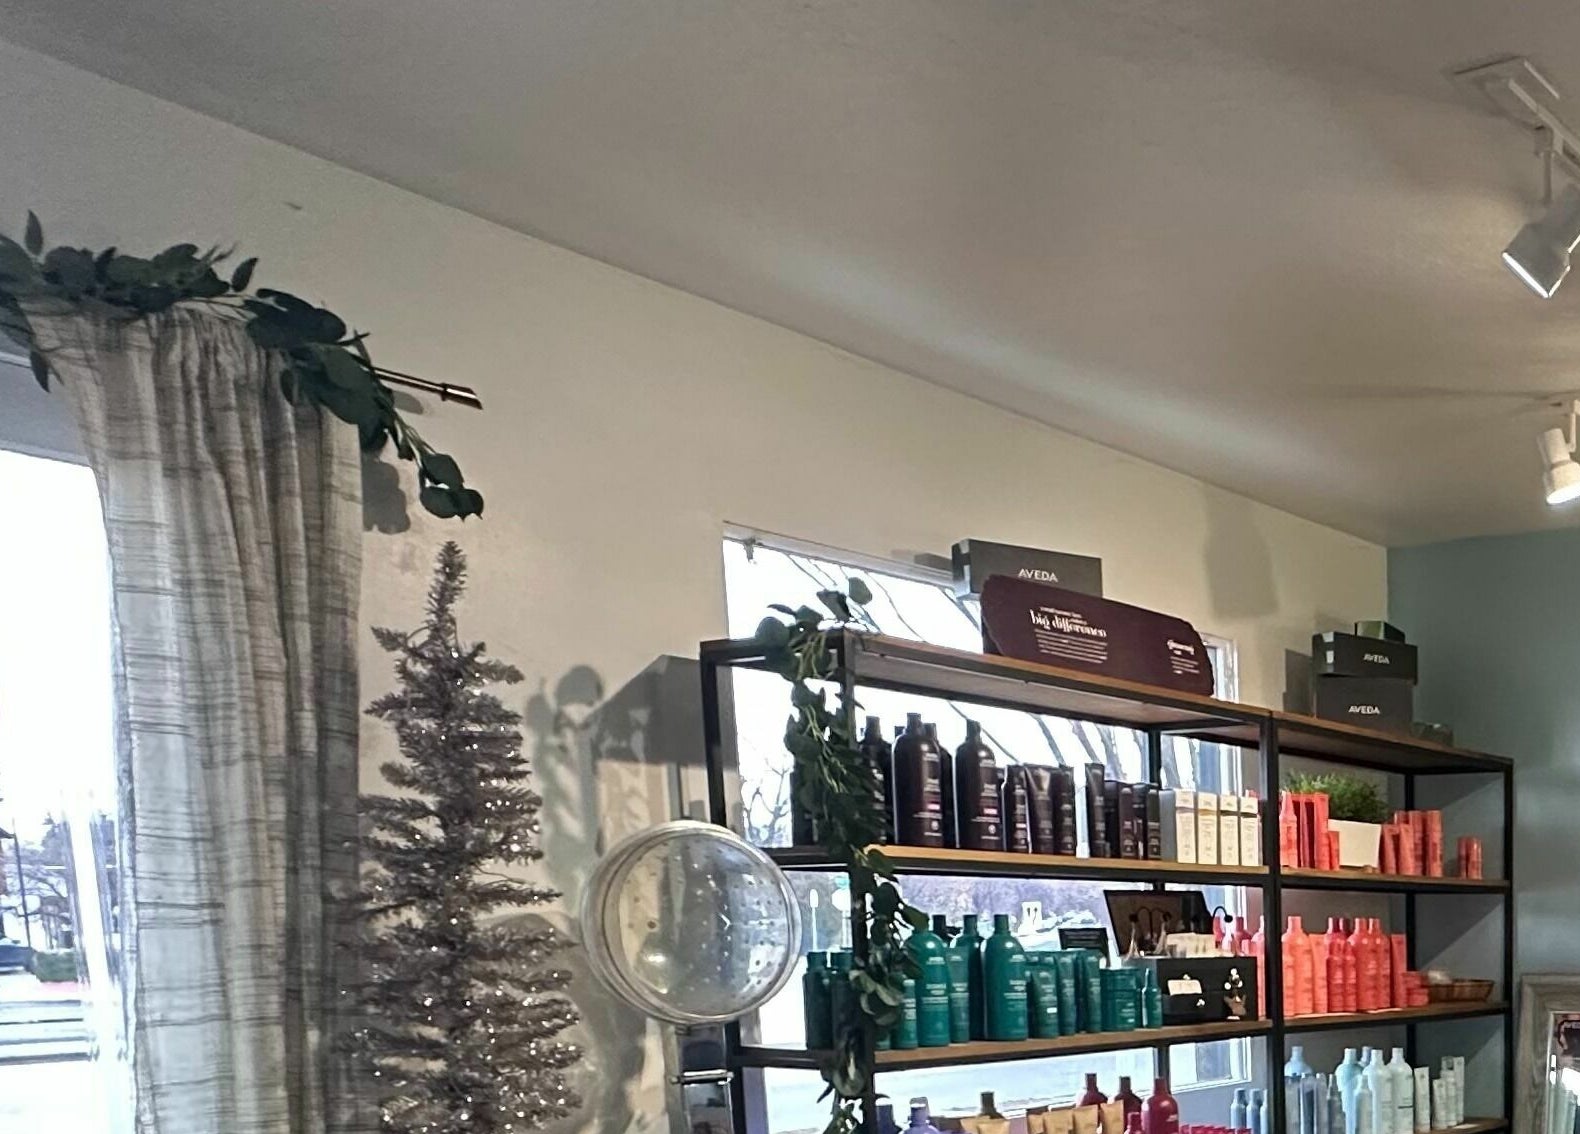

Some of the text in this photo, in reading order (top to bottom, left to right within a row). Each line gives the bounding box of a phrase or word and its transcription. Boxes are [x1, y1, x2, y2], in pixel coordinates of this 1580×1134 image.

[1018, 568, 1058, 582] AVEDA
[1029, 608, 1051, 631] big
[1363, 653, 1390, 664] AVEDA
[1348, 705, 1381, 714] AVEDA
